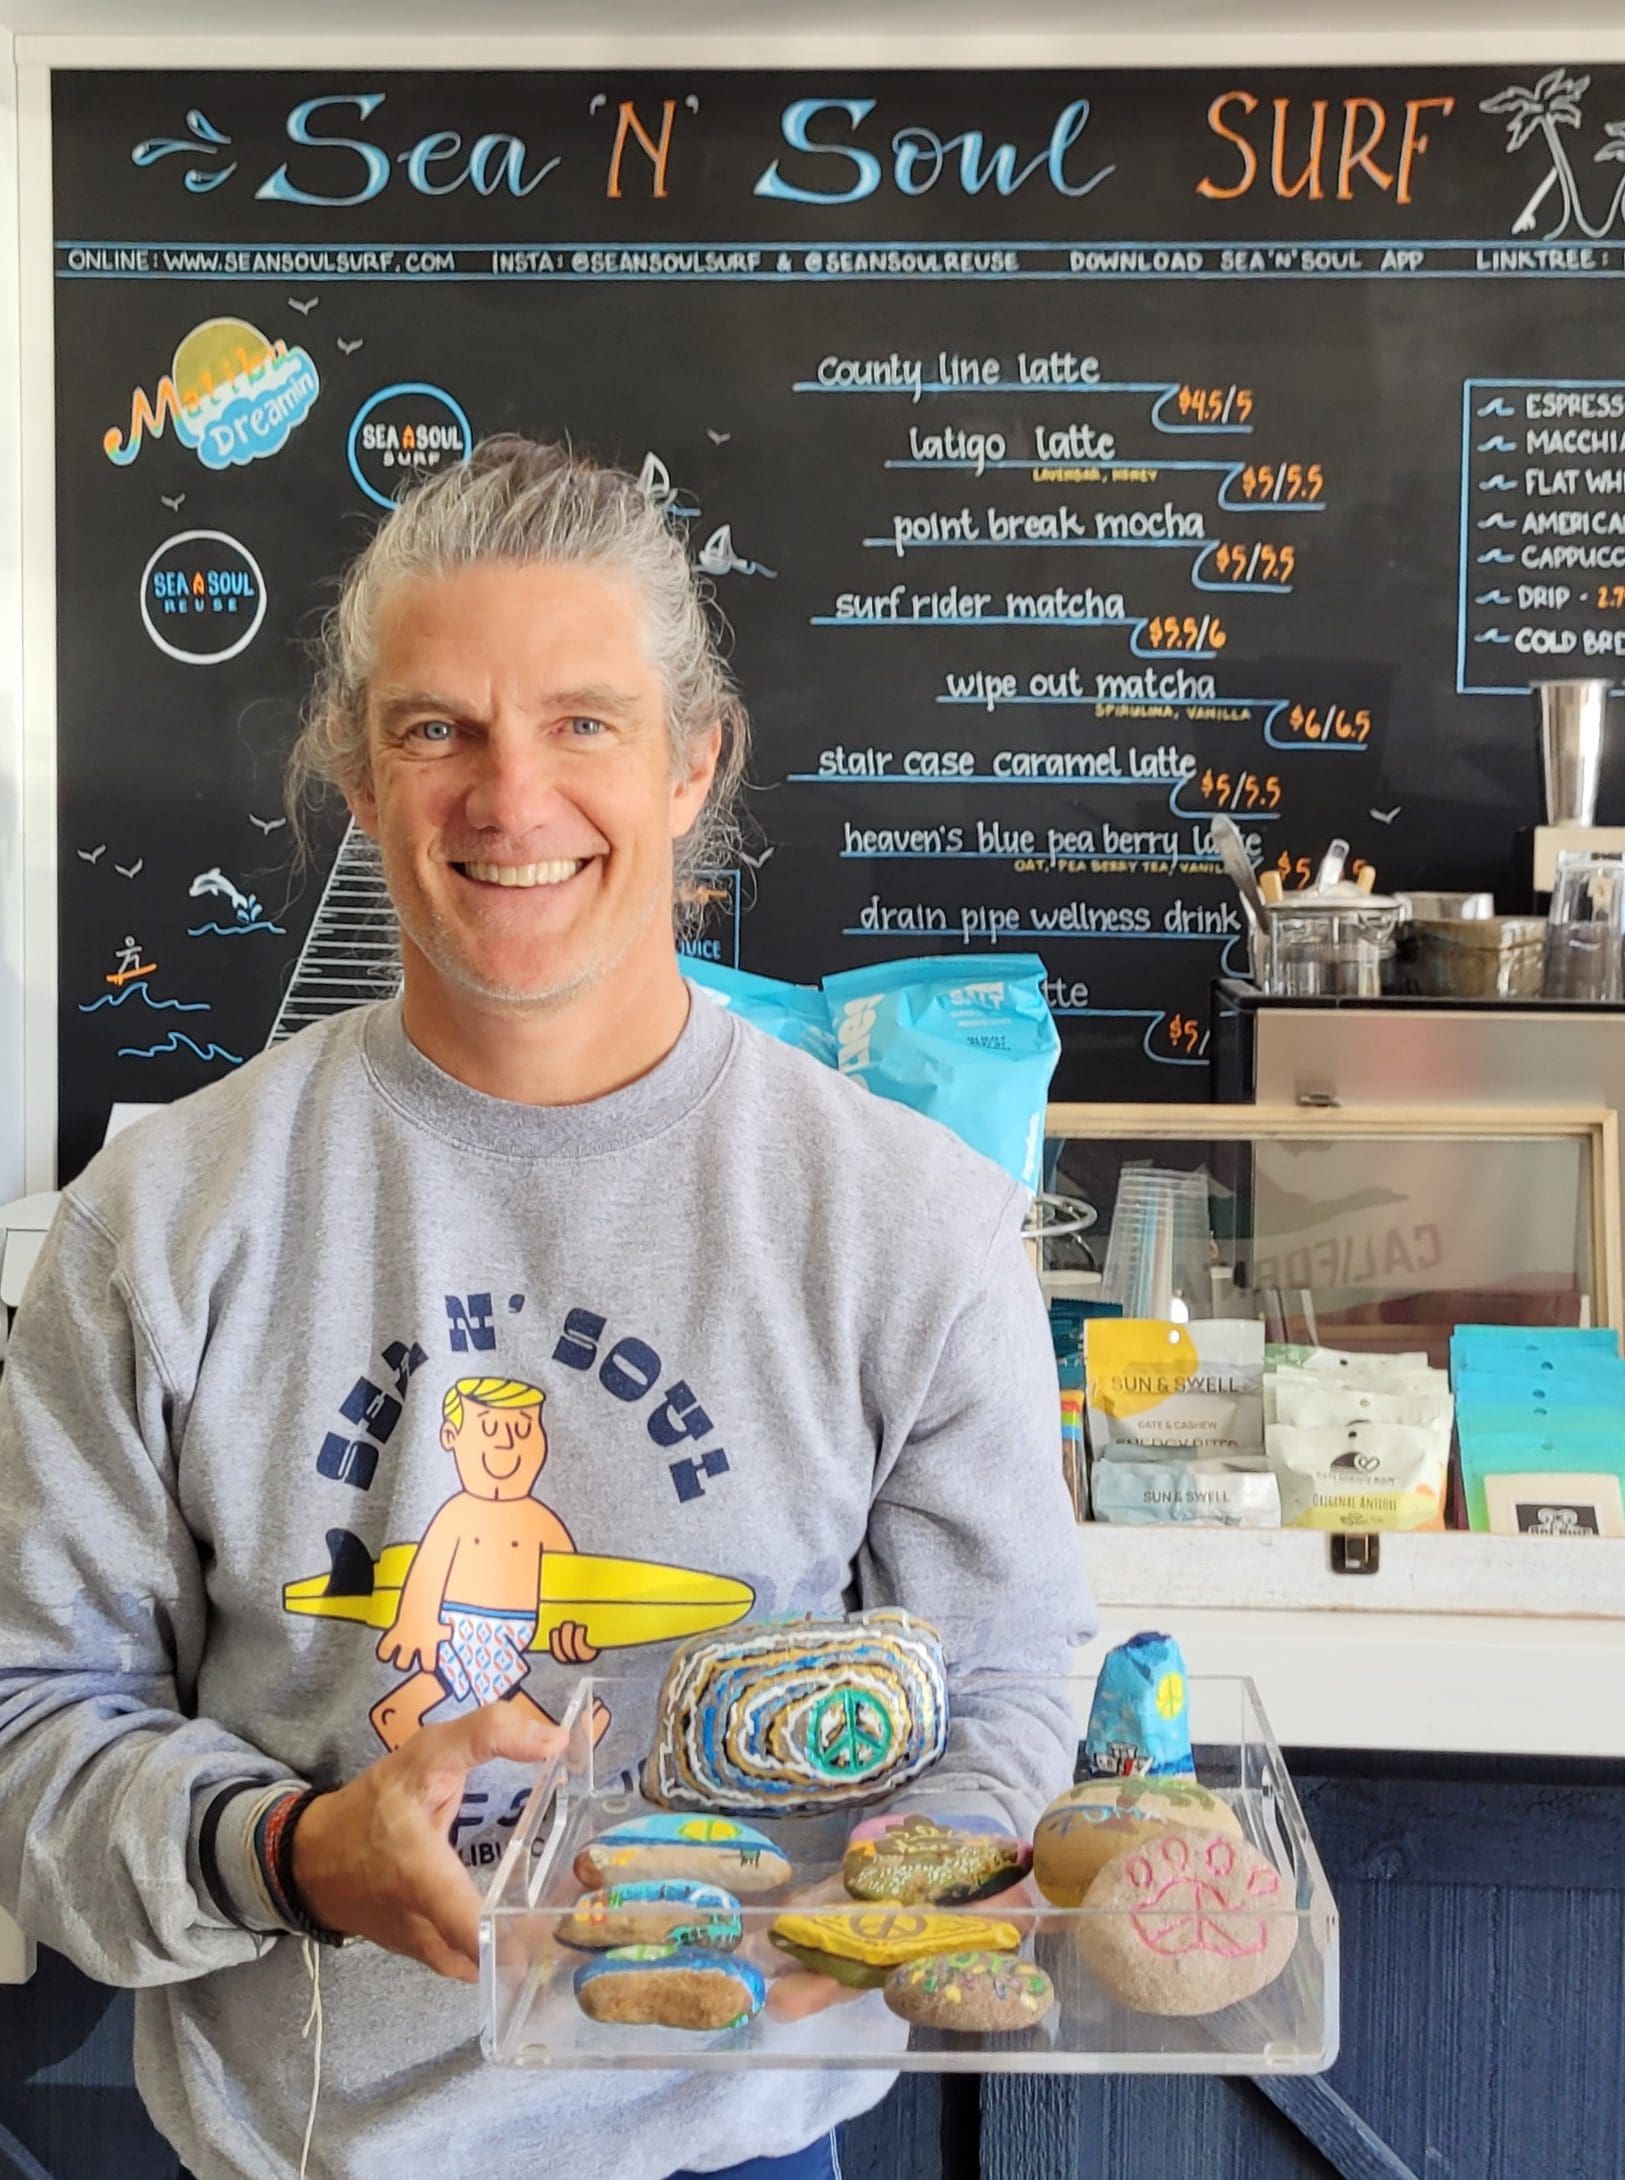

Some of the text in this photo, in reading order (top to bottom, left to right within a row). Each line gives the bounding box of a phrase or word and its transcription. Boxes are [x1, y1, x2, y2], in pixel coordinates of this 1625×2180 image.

[255, 92, 562, 207] Sea
[753, 97, 1117, 207] Soul
[1196, 90, 1455, 204] SURF
[570, 250, 761, 273] @SEANSOULSURF
[776, 253, 793, 272] &
[804, 250, 1020, 273] @SEANSOULREUSE
[1069, 250, 1203, 272] DOWNLOAD
[1380, 250, 1425, 271] APP
[938, 352, 1000, 384] line
[1018, 352, 1100, 384] latte
[207, 373, 316, 456] Dreamin
[1180, 384, 1253, 424] $4.5/5
[362, 423, 400, 450] SEA
[416, 423, 463, 450] SOUL
[908, 424, 1116, 477] latigo latte
[383, 450, 441, 467] SURF
[1242, 462, 1325, 502] $5/5.5
[1525, 468, 1580, 496] FLAT
[893, 503, 1205, 557] point break mocha
[1521, 511, 1625, 536] AMERICA
[1216, 542, 1295, 581] $5/5.5
[153, 571, 189, 597] SEA
[208, 571, 254, 597] SOUL
[1518, 584, 1571, 610] DRIP
[164, 598, 237, 614] REUSE
[835, 586, 1126, 618] surf rider matcha
[1148, 614, 1227, 651] $5.5/6
[1514, 626, 1577, 653] COLD
[946, 669, 1216, 712] wipe out matcha
[1186, 706, 1252, 721] VANILLA
[1289, 704, 1371, 742] $6/6.5
[819, 746, 1197, 781] stair case caramel latte
[1200, 768, 1281, 810] $5/5.5
[844, 824, 963, 853] heaven's
[976, 822, 1035, 853] blue
[1048, 829, 1096, 868] pea
[1102, 823, 1180, 876] berry
[1058, 860, 1087, 872] PEA
[859, 895, 1241, 944] drain pipe wellness drink
[1111, 1377, 1239, 1393] SUN & SWELL
[316, 1341, 429, 1491] SEA
[552, 1308, 730, 1503] SOUL
[1143, 1491, 1172, 1502] SUN
[1186, 1491, 1230, 1503] SWELL
